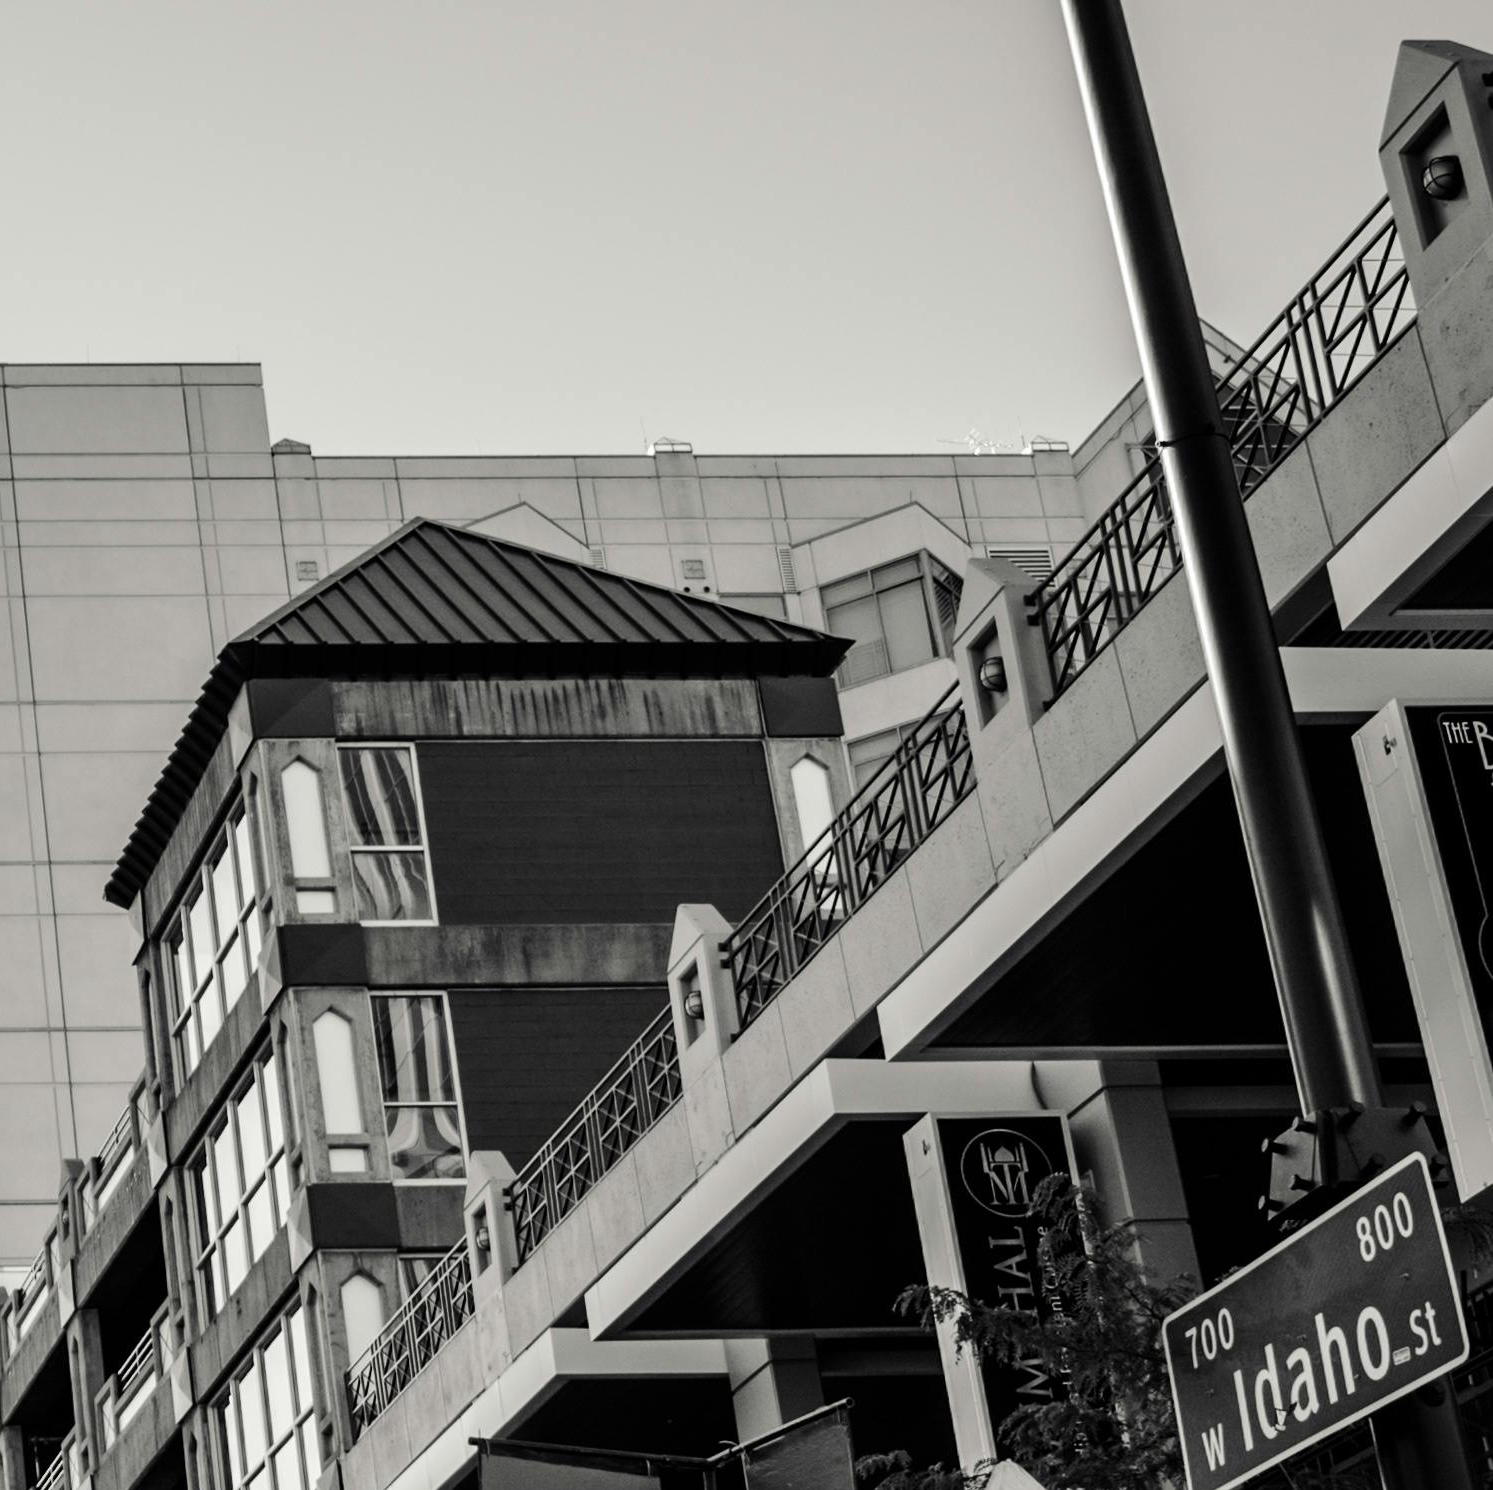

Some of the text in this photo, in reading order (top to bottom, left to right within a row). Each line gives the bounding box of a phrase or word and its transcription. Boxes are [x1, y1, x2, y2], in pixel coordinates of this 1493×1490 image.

[1442, 721, 1474, 744] THE
[1355, 1191, 1415, 1263] 800
[987, 1224, 1055, 1400] MHAL
[1184, 1307, 1235, 1370] 700
[1201, 1422, 1226, 1472] W
[1233, 1305, 1391, 1452] Idaho
